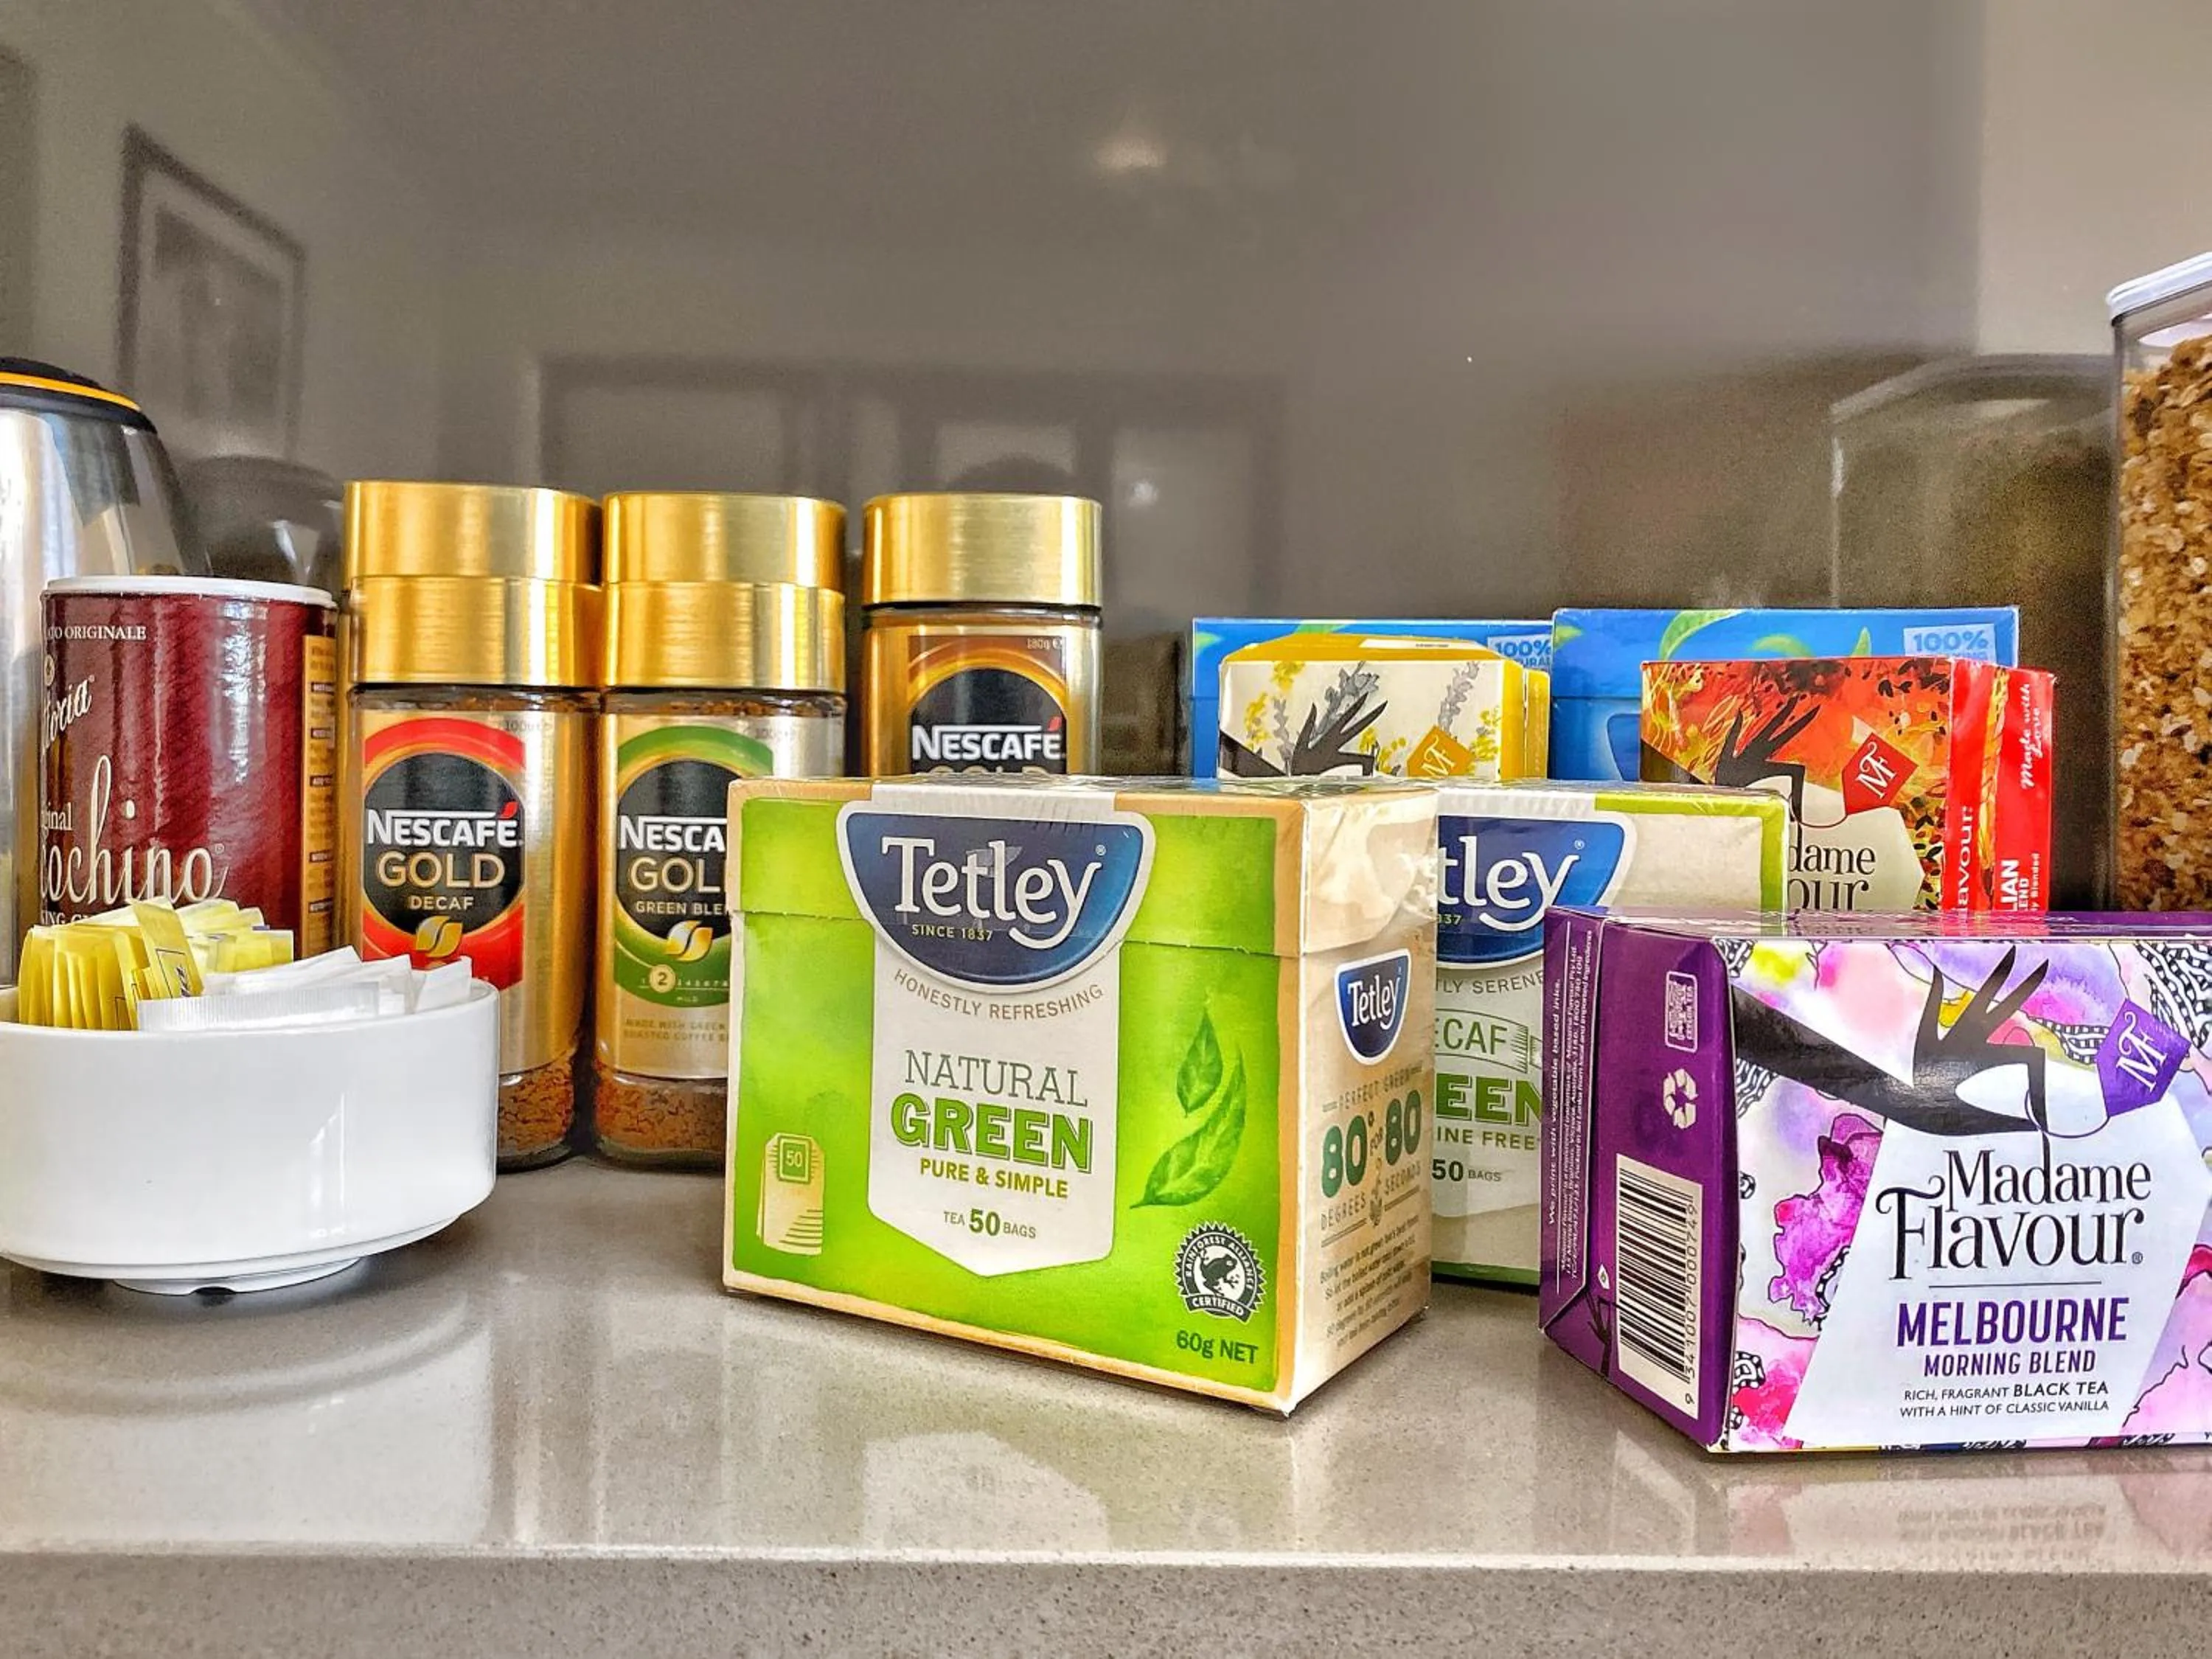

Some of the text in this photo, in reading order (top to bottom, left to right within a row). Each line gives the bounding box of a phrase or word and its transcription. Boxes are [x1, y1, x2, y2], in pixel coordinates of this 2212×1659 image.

[64, 625, 147, 640] ORIGINALE
[1495, 639, 1551, 656] 100%
[1913, 629, 1989, 652] 100%
[2020, 684, 2030, 723] with
[619, 815, 727, 852] NESCA
[378, 850, 506, 888] GOLD
[630, 855, 721, 894] GOL
[1437, 835, 1580, 931] tley
[410, 896, 474, 911] DECAF
[636, 900, 723, 916] GREEN BLE
[882, 836, 1102, 950] Tetley
[2019, 877, 2029, 908] END
[911, 924, 993, 942] SINCE 1837
[658, 971, 667, 986] 2
[894, 968, 1104, 1020] HONESTLY REFRESHING
[1347, 975, 1401, 1030] Tetley
[1436, 1018, 1508, 1055] CAF
[1551, 1014, 1559, 1054] based
[905, 1049, 1088, 1107] NATURAL
[1551, 1057, 1559, 1122] vegetable
[1436, 1072, 1543, 1128] EEN
[891, 1092, 1093, 1175] GREEN
[1385, 1089, 1422, 1166] 80
[1437, 1126, 1535, 1151] INE FREE
[785, 1150, 803, 1168] 50
[1431, 1158, 1502, 1182] 50 BAGS
[1944, 1140, 2152, 1213] Madame
[920, 1158, 1068, 1199] PURE & SIMPLE
[943, 1208, 1037, 1239] TEA 50 BAGS
[1549, 1200, 1556, 1225] We
[1875, 1175, 2145, 1281] Flavour
[1186, 1236, 1225, 1277] RAINFOREST
[1192, 1297, 1245, 1317] CERTIFIED
[1685, 1203, 1698, 1405] 9 341007 000749
[1896, 1297, 2130, 1348] MELBOURNE
[1176, 1329, 1259, 1364] 60g NET
[1924, 1349, 2096, 1377] MORNING BLEND
[1900, 1399, 2110, 1418] WITH A HINT OF CLASSIC VANILLA
[1905, 1380, 2109, 1402] RICH, FRAGRANT BLACK TEA
